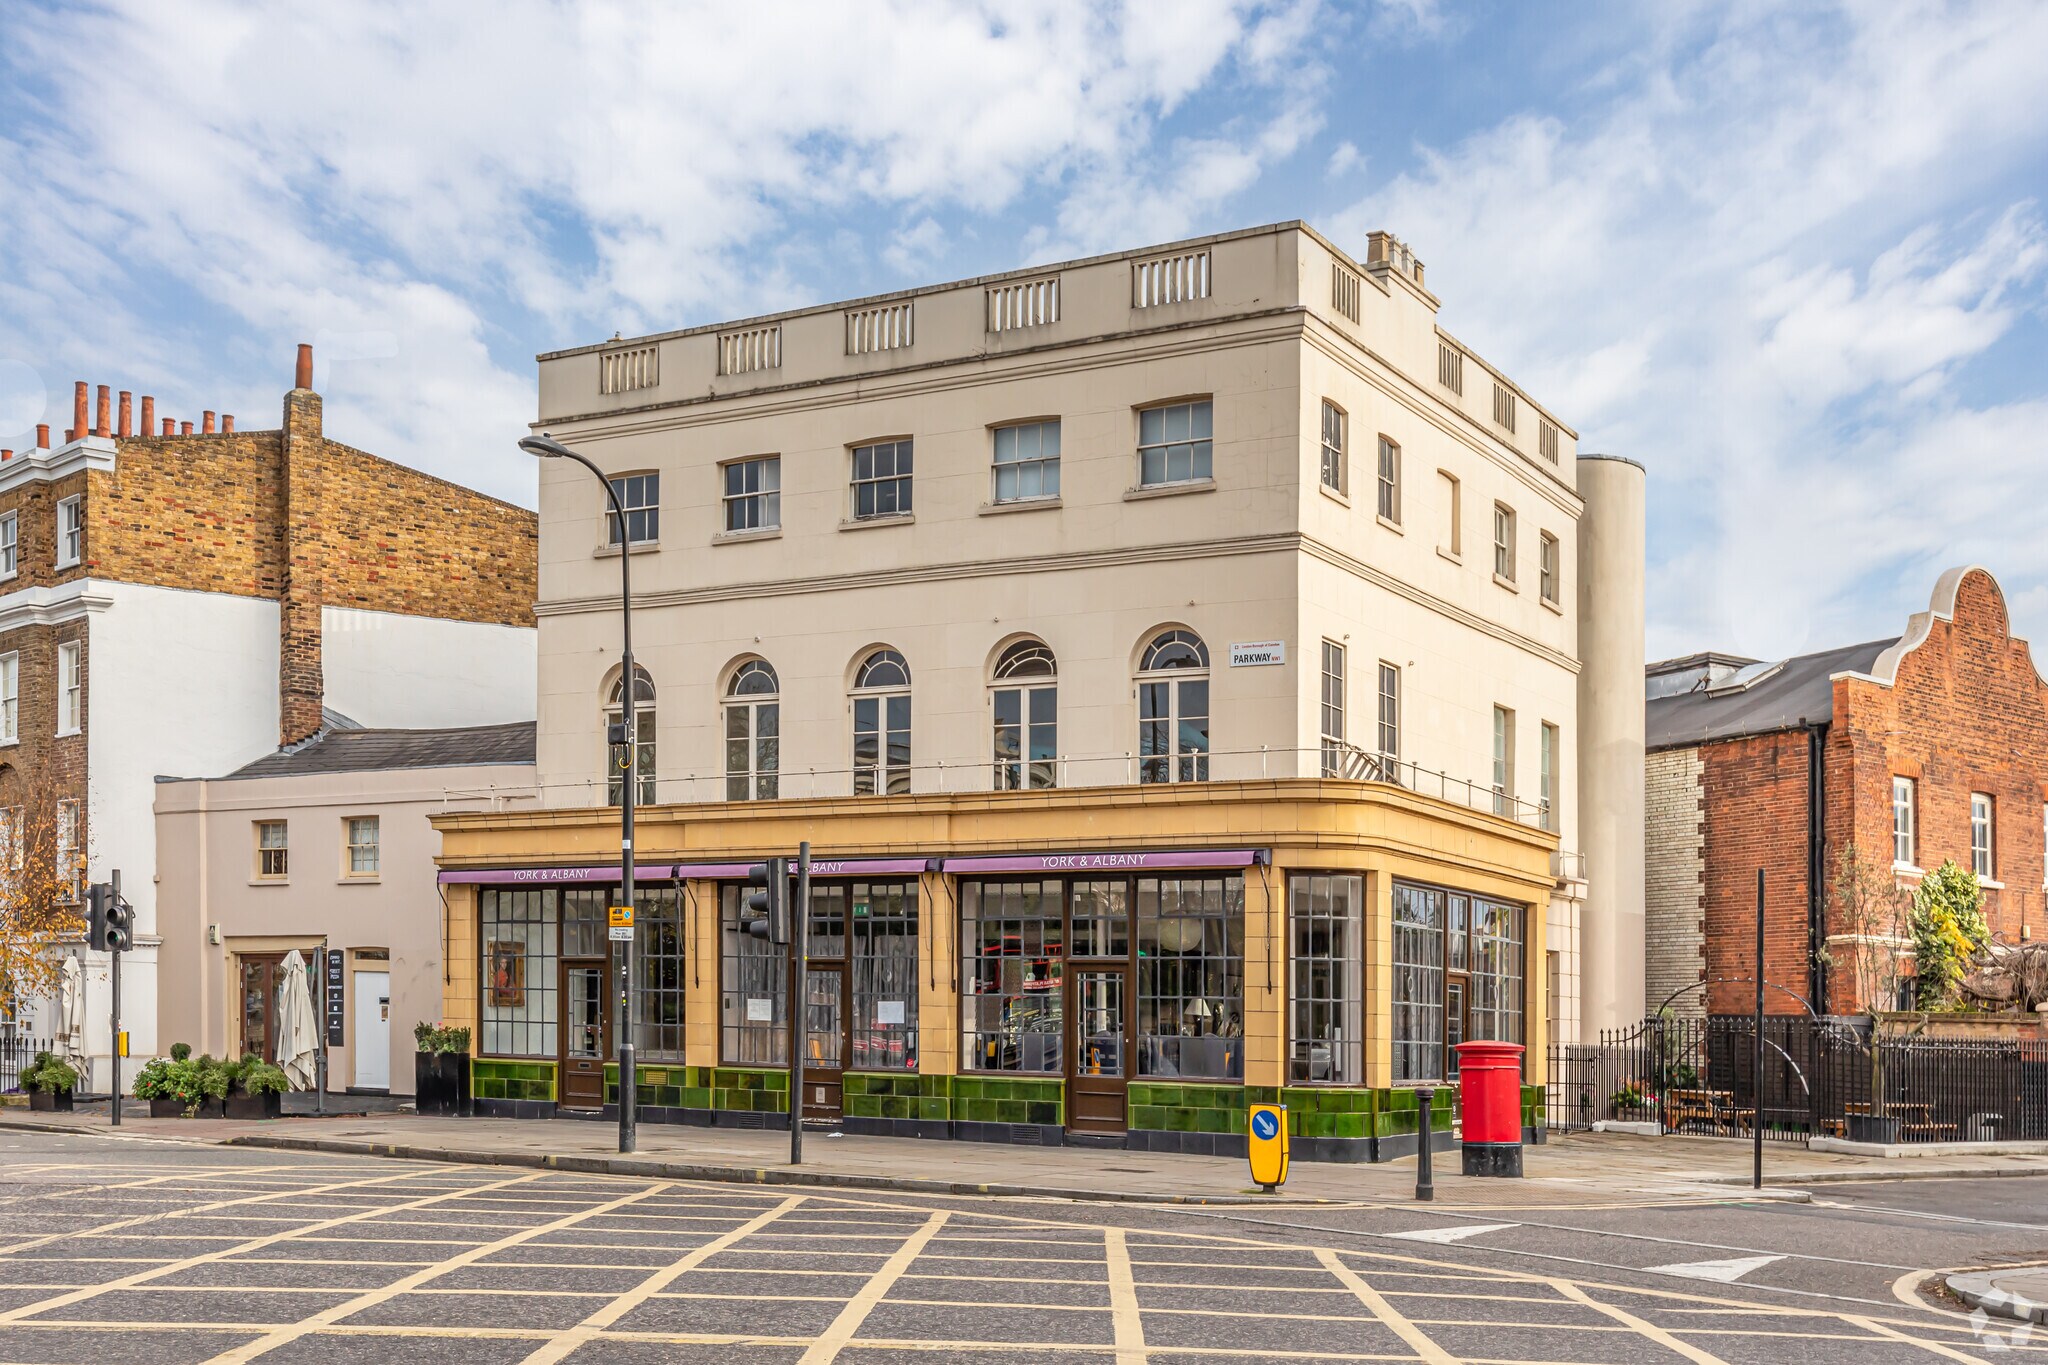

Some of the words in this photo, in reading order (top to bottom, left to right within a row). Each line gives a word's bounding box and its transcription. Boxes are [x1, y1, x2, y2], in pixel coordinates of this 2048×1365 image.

[1234, 653, 1271, 664] PARKWAY
[1041, 856, 1075, 867] YORK
[1079, 855, 1088, 867] &
[1093, 854, 1147, 866] ALBANY
[797, 862, 845, 873] BANY
[513, 870, 539, 880] YORK
[541, 870, 548, 880] &
[551, 868, 591, 879] ALBANY
